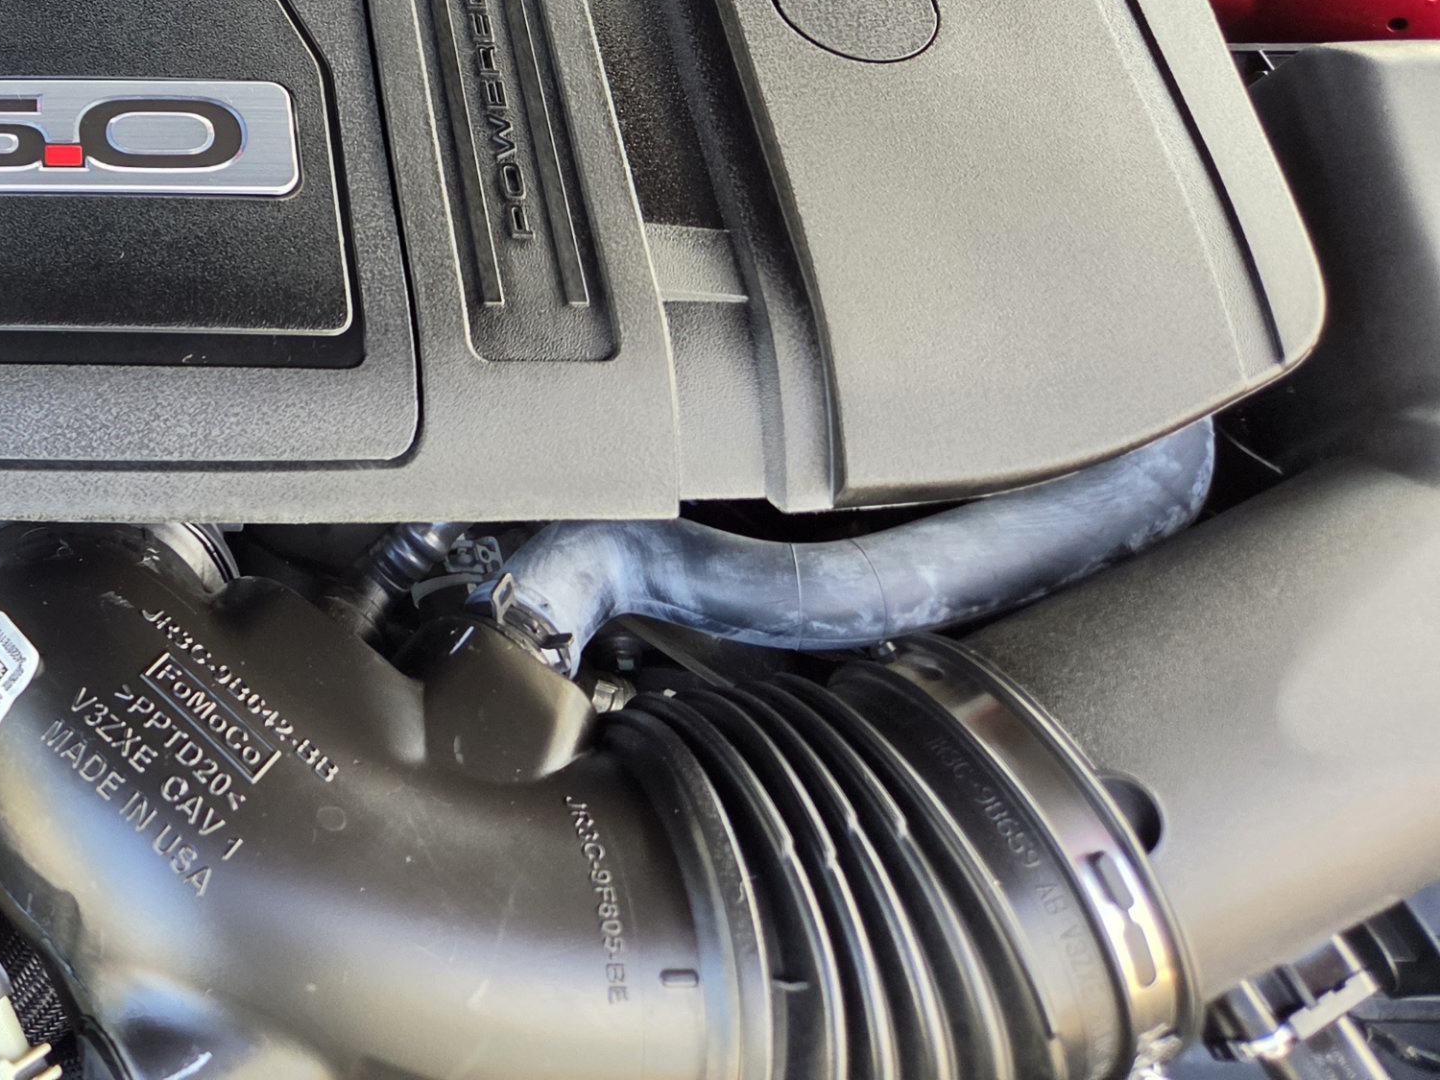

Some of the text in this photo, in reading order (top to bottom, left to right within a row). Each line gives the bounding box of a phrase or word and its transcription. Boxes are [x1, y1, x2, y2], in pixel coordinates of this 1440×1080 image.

[70, 686, 159, 773] V3ZXE
[156, 662, 262, 767] FoMoCo
[39, 719, 213, 898] MADE IN USA
